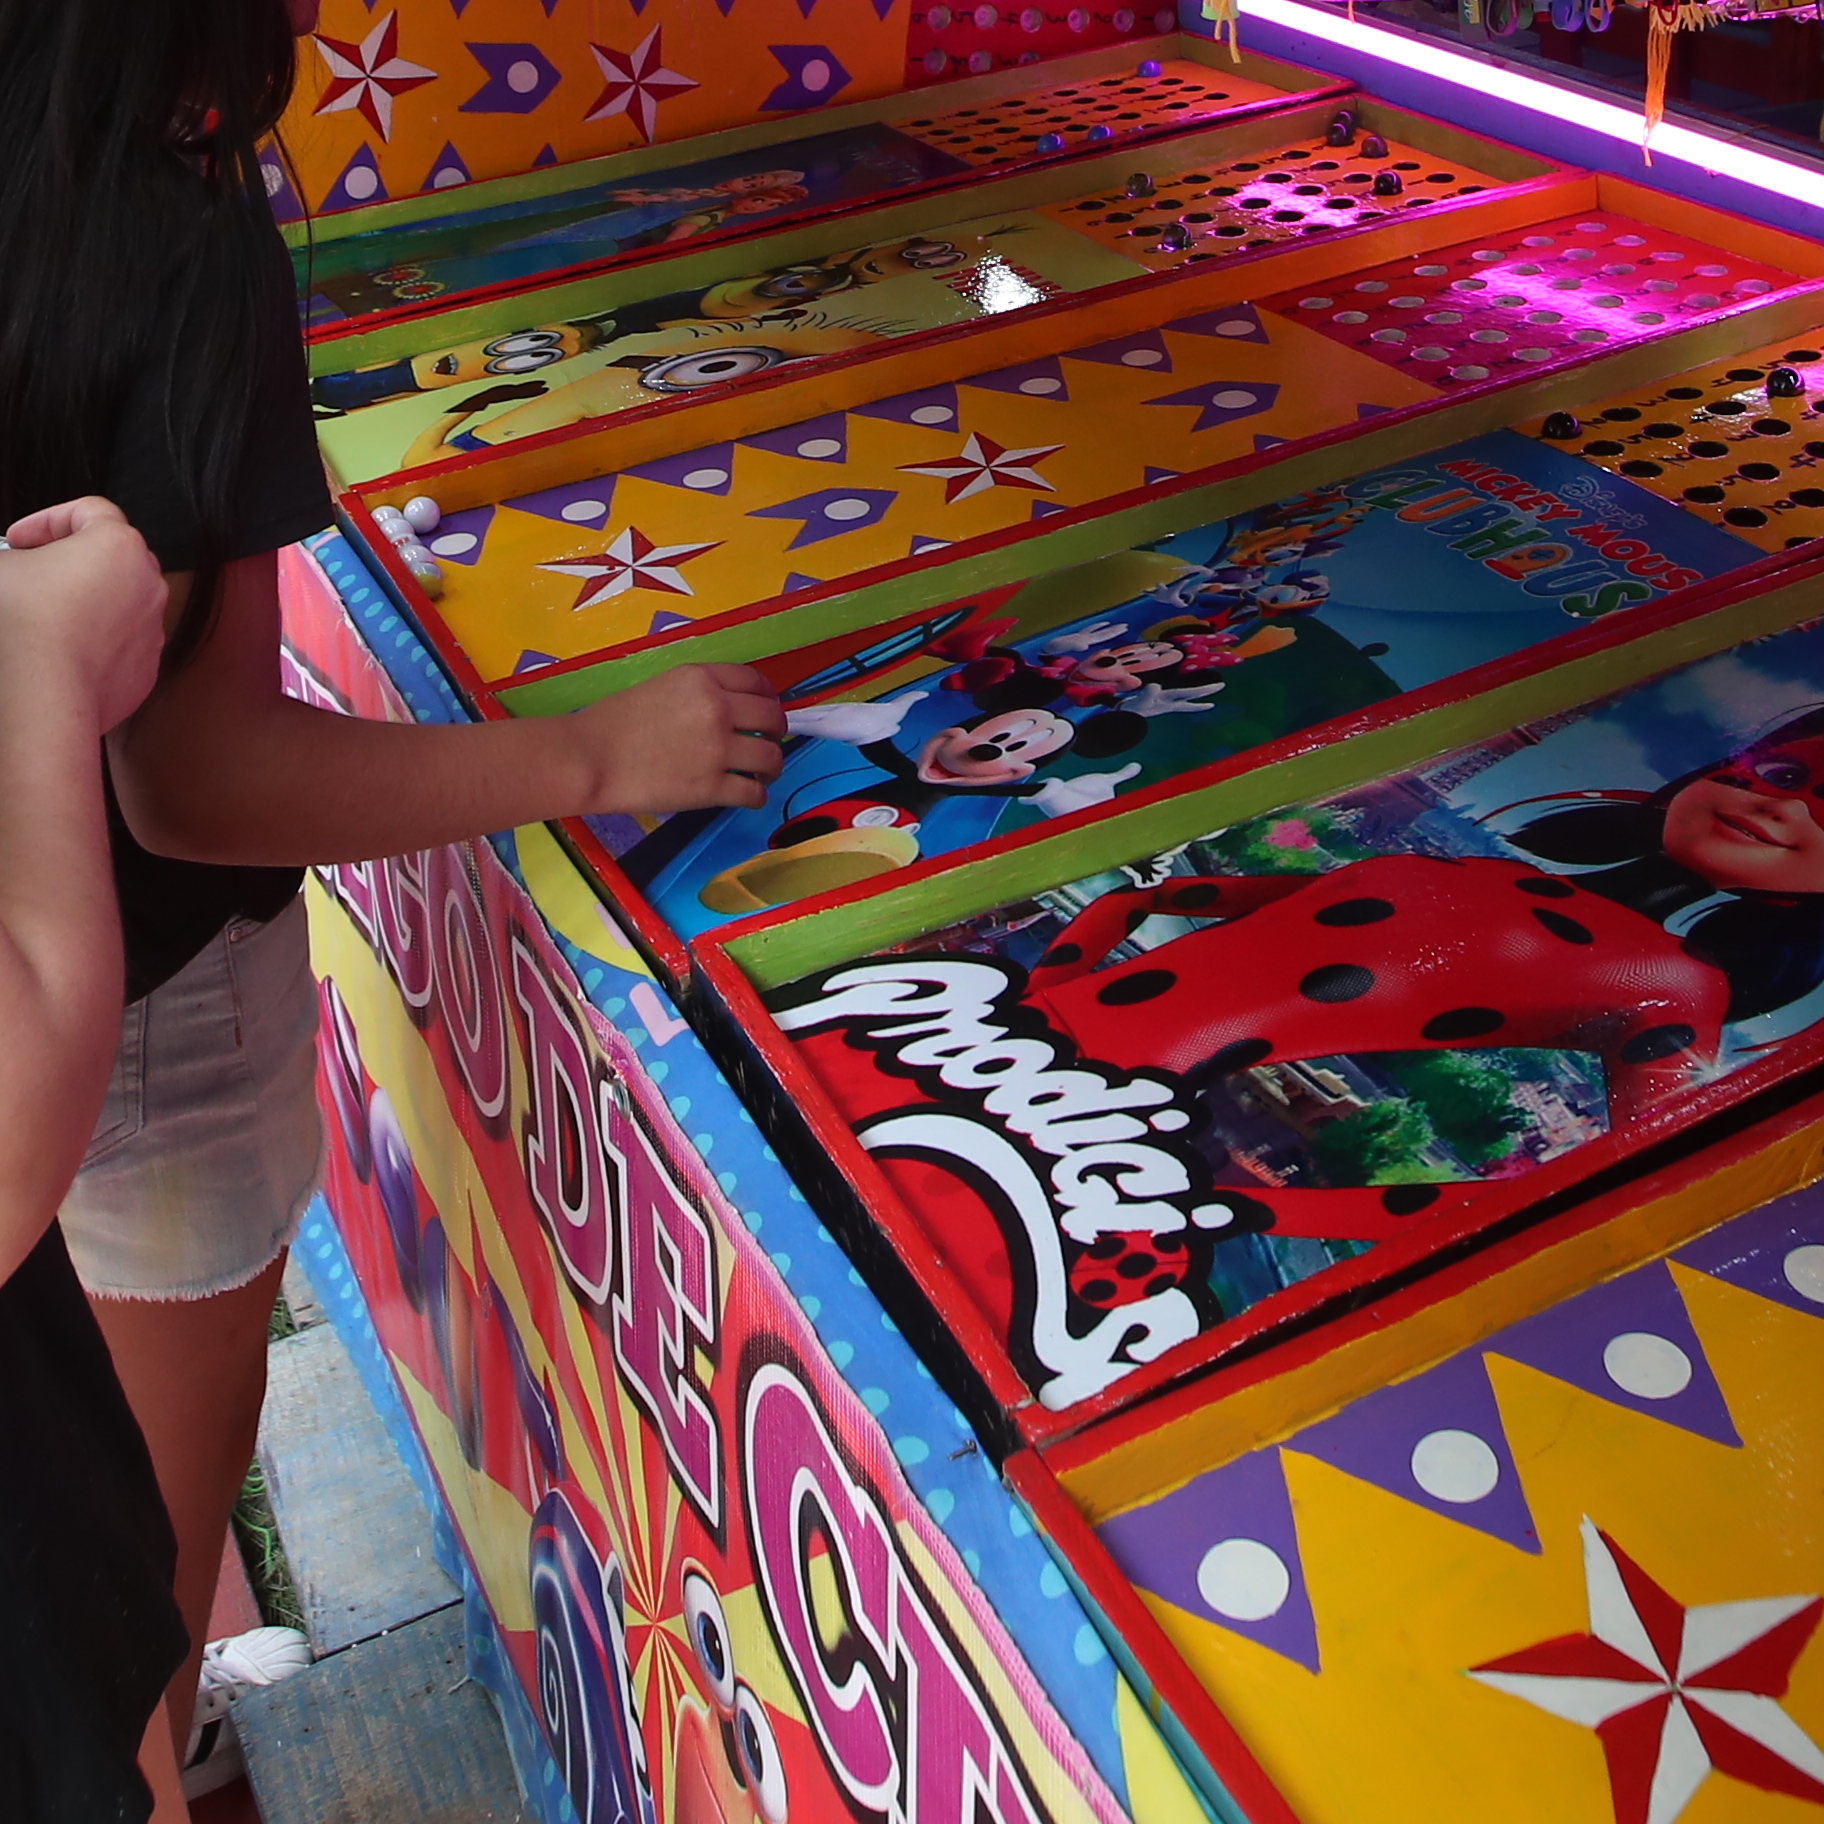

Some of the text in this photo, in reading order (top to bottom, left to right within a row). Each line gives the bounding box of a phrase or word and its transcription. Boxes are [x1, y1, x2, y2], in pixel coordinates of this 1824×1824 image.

[1341, 469, 1654, 618] CLUBHOUS
[1436, 458, 1704, 592] MICKEY MOUS
[509, 933, 727, 1527] DE
